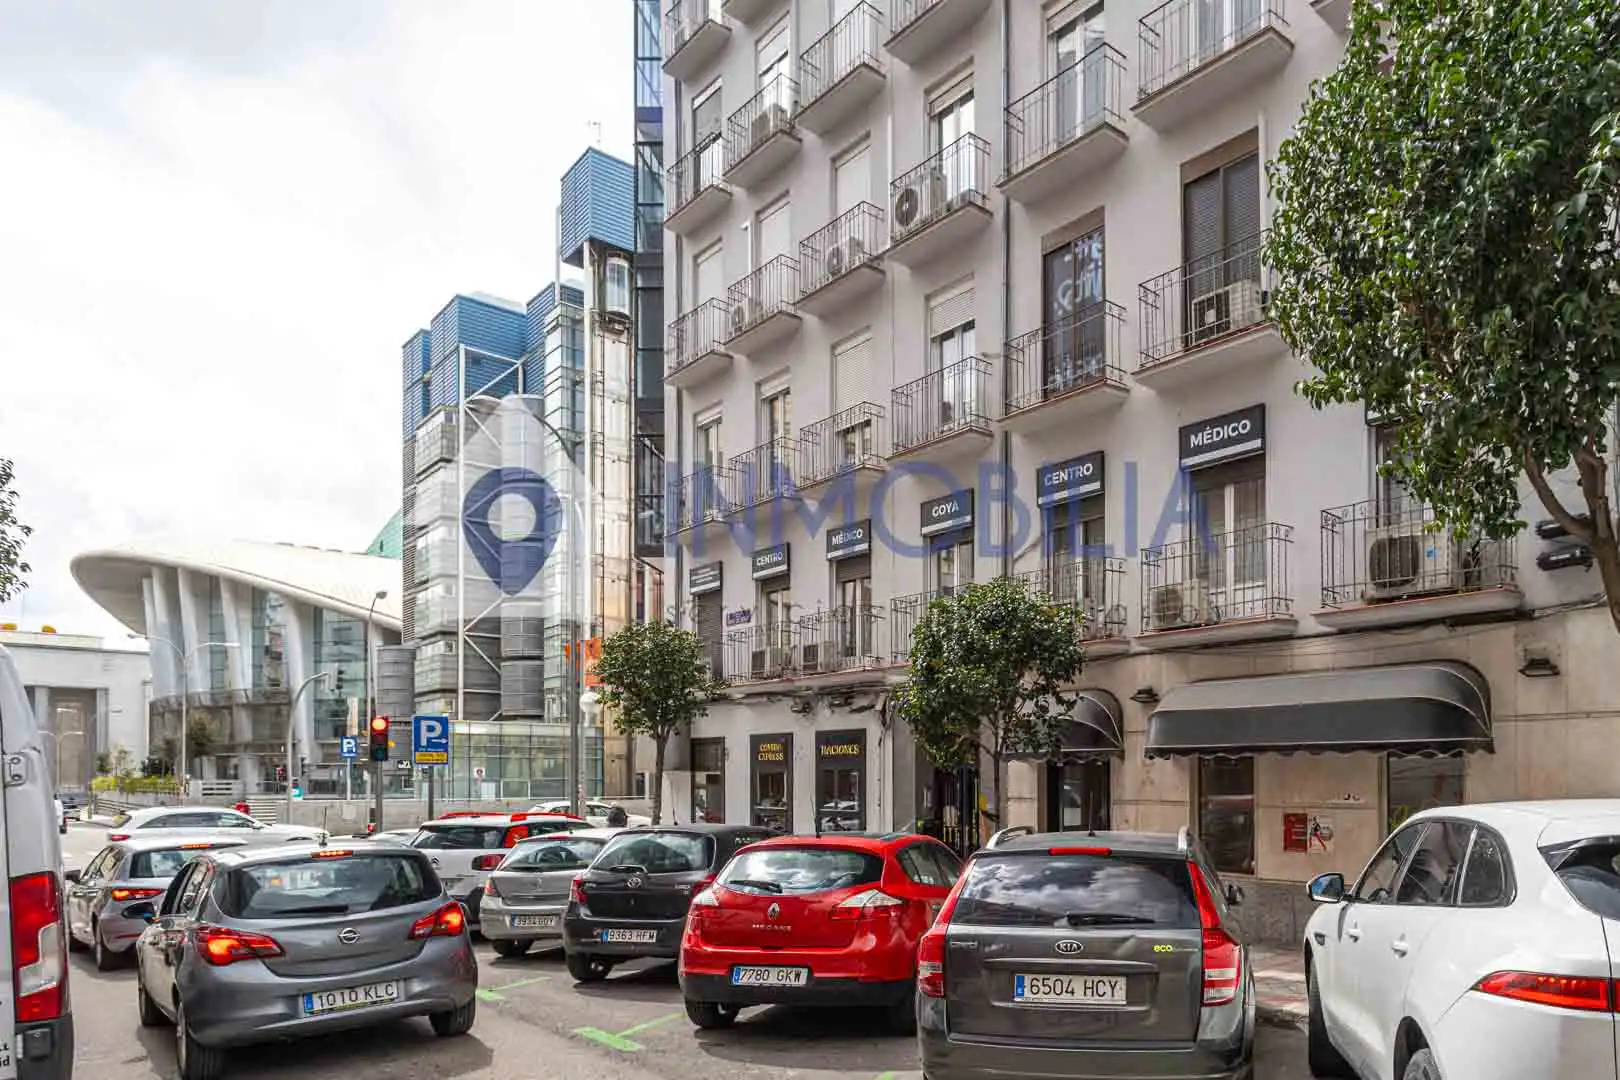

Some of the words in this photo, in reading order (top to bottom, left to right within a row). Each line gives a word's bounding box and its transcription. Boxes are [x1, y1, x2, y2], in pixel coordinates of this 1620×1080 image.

[1190, 419, 1251, 448] MÉDICO
[1044, 463, 1093, 486] CENTRO
[932, 499, 960, 518] GOYA
[831, 528, 863, 545] MÉDICO
[756, 551, 783, 566] CENTRO
[420, 719, 442, 746] P
[609, 928, 633, 941] 9363
[1060, 943, 1079, 951] KIA
[741, 969, 770, 982] 7780
[777, 969, 802, 983] GKW
[319, 990, 358, 1009] 1010
[363, 983, 394, 1000] KLC
[1030, 977, 1075, 996] 6504
[1083, 979, 1118, 998] HCY
